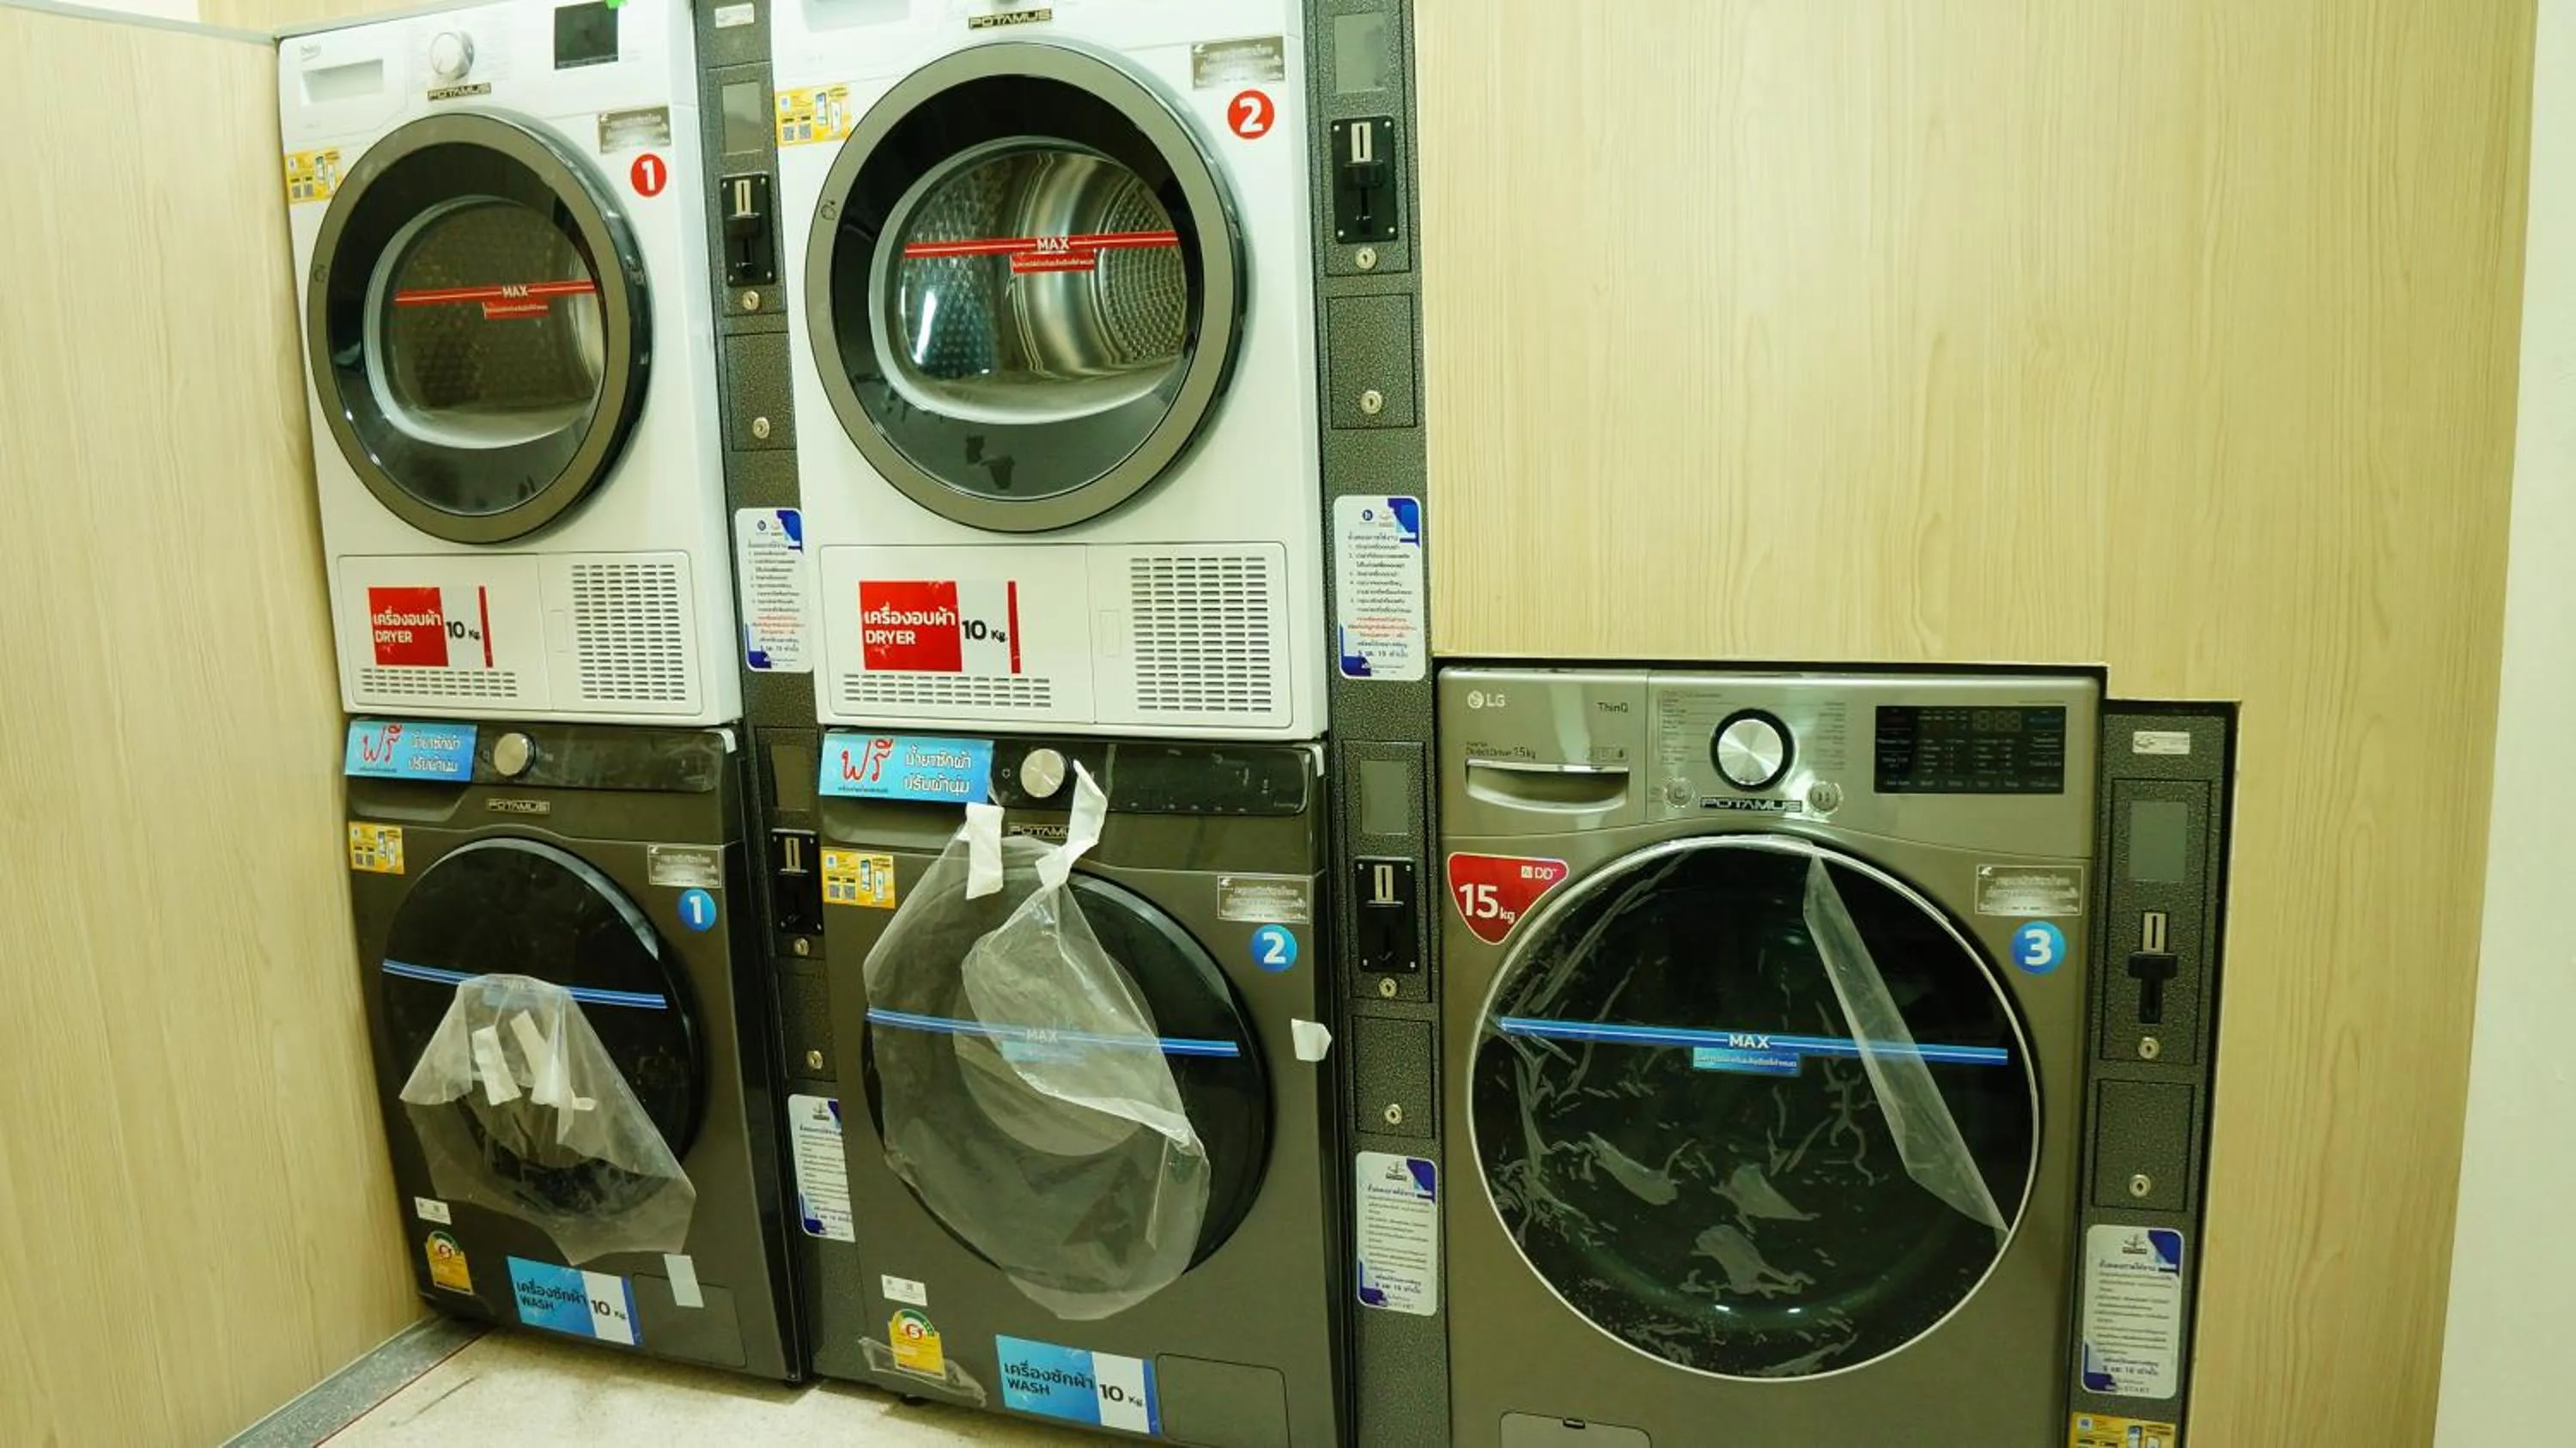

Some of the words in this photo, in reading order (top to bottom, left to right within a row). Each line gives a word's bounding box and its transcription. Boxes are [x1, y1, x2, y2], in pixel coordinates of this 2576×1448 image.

[969, 9, 1050, 28] POTAMUS
[1239, 97, 1264, 133] 2
[641, 160, 655, 192] 1
[1036, 237, 1070, 250] MAX
[501, 285, 529, 297] MAX
[374, 605, 441, 626] เครื่องอบผ้า
[864, 601, 956, 626] เครื่องอบผ้า
[375, 630, 412, 643] DRYER
[447, 621, 465, 638] 10
[866, 630, 915, 644] DRYER
[962, 620, 987, 640] 10
[1486, 694, 1505, 707] LG
[1597, 702, 1628, 713] ThinQ
[360, 723, 402, 763] ฟรี
[841, 739, 894, 782] ฟรี
[1702, 798, 1801, 812] POTAMUS
[690, 896, 702, 924] 1
[1263, 932, 1286, 964] 2
[2024, 929, 2051, 965] 3
[1729, 1033, 1771, 1049] MAX
[591, 1299, 611, 1316] 10
[1004, 1361, 1095, 1390] เครื่องซักผ้า
[1007, 1378, 1050, 1396] WASH
[1099, 1384, 1124, 1402] 10
